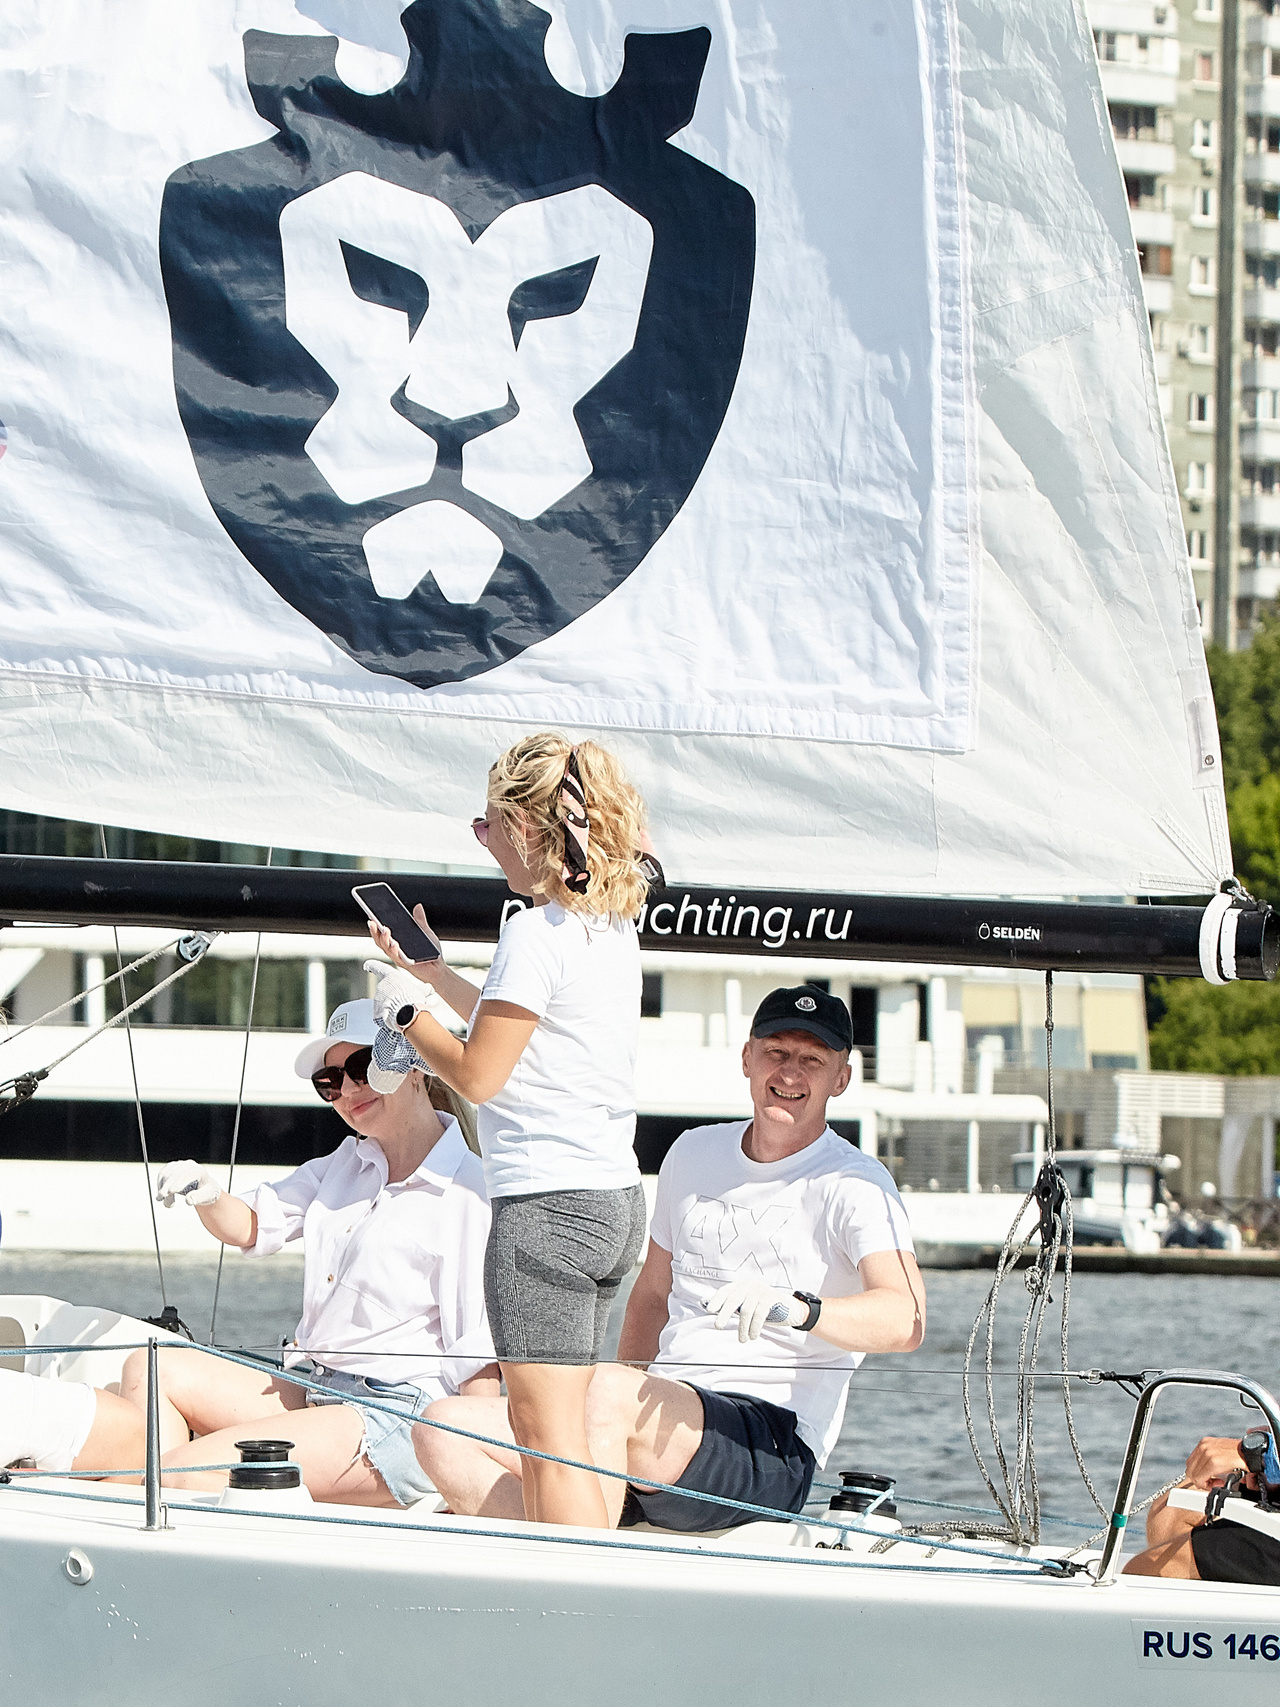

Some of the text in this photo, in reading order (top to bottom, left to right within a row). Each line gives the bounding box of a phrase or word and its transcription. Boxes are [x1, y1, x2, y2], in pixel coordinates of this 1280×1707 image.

[499, 893, 853, 949] pchting.ru
[992, 925, 1041, 941] SELDÉN
[1143, 1630, 1213, 1660] RUS
